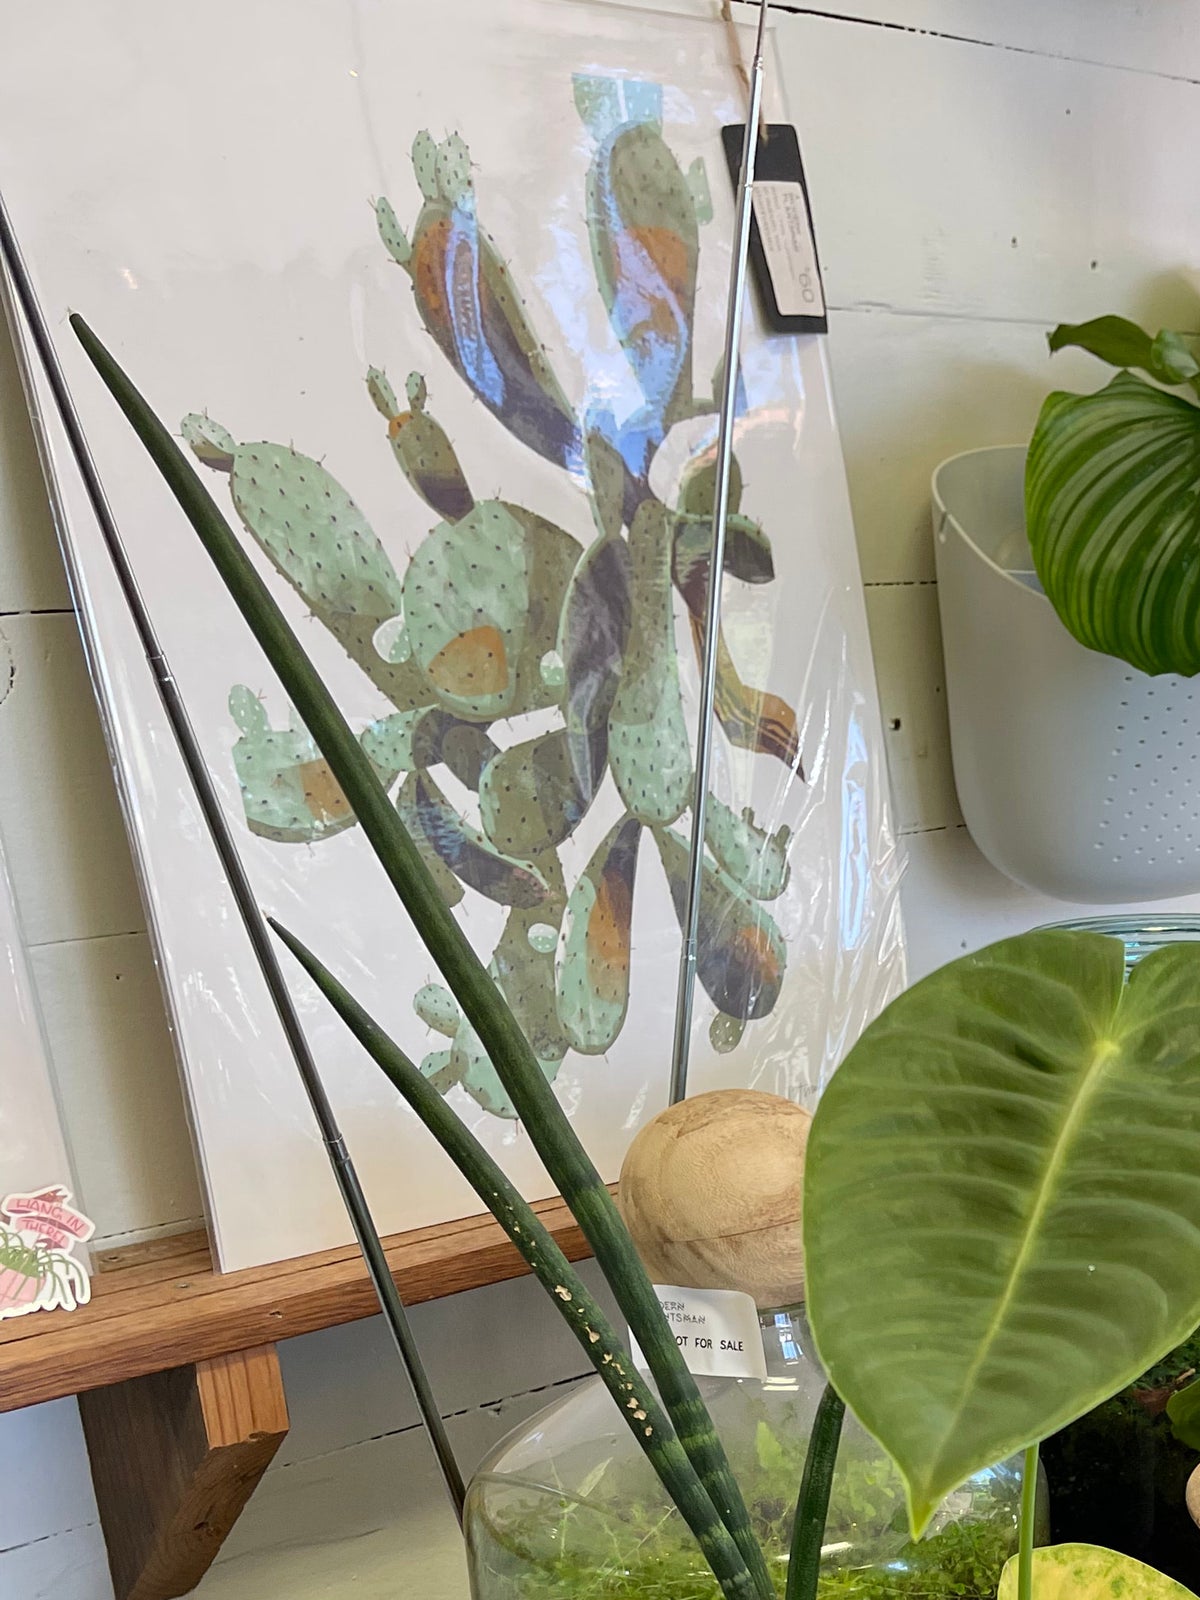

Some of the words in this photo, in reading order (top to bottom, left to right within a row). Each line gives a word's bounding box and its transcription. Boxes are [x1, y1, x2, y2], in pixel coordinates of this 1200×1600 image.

[16, 1200, 63, 1220] HANG
[66, 1215, 84, 1232] IN
[659, 1301, 685, 1311] DERN
[675, 1336, 688, 1346] OT
[695, 1337, 713, 1349] FOR
[719, 1340, 744, 1351] SALE
